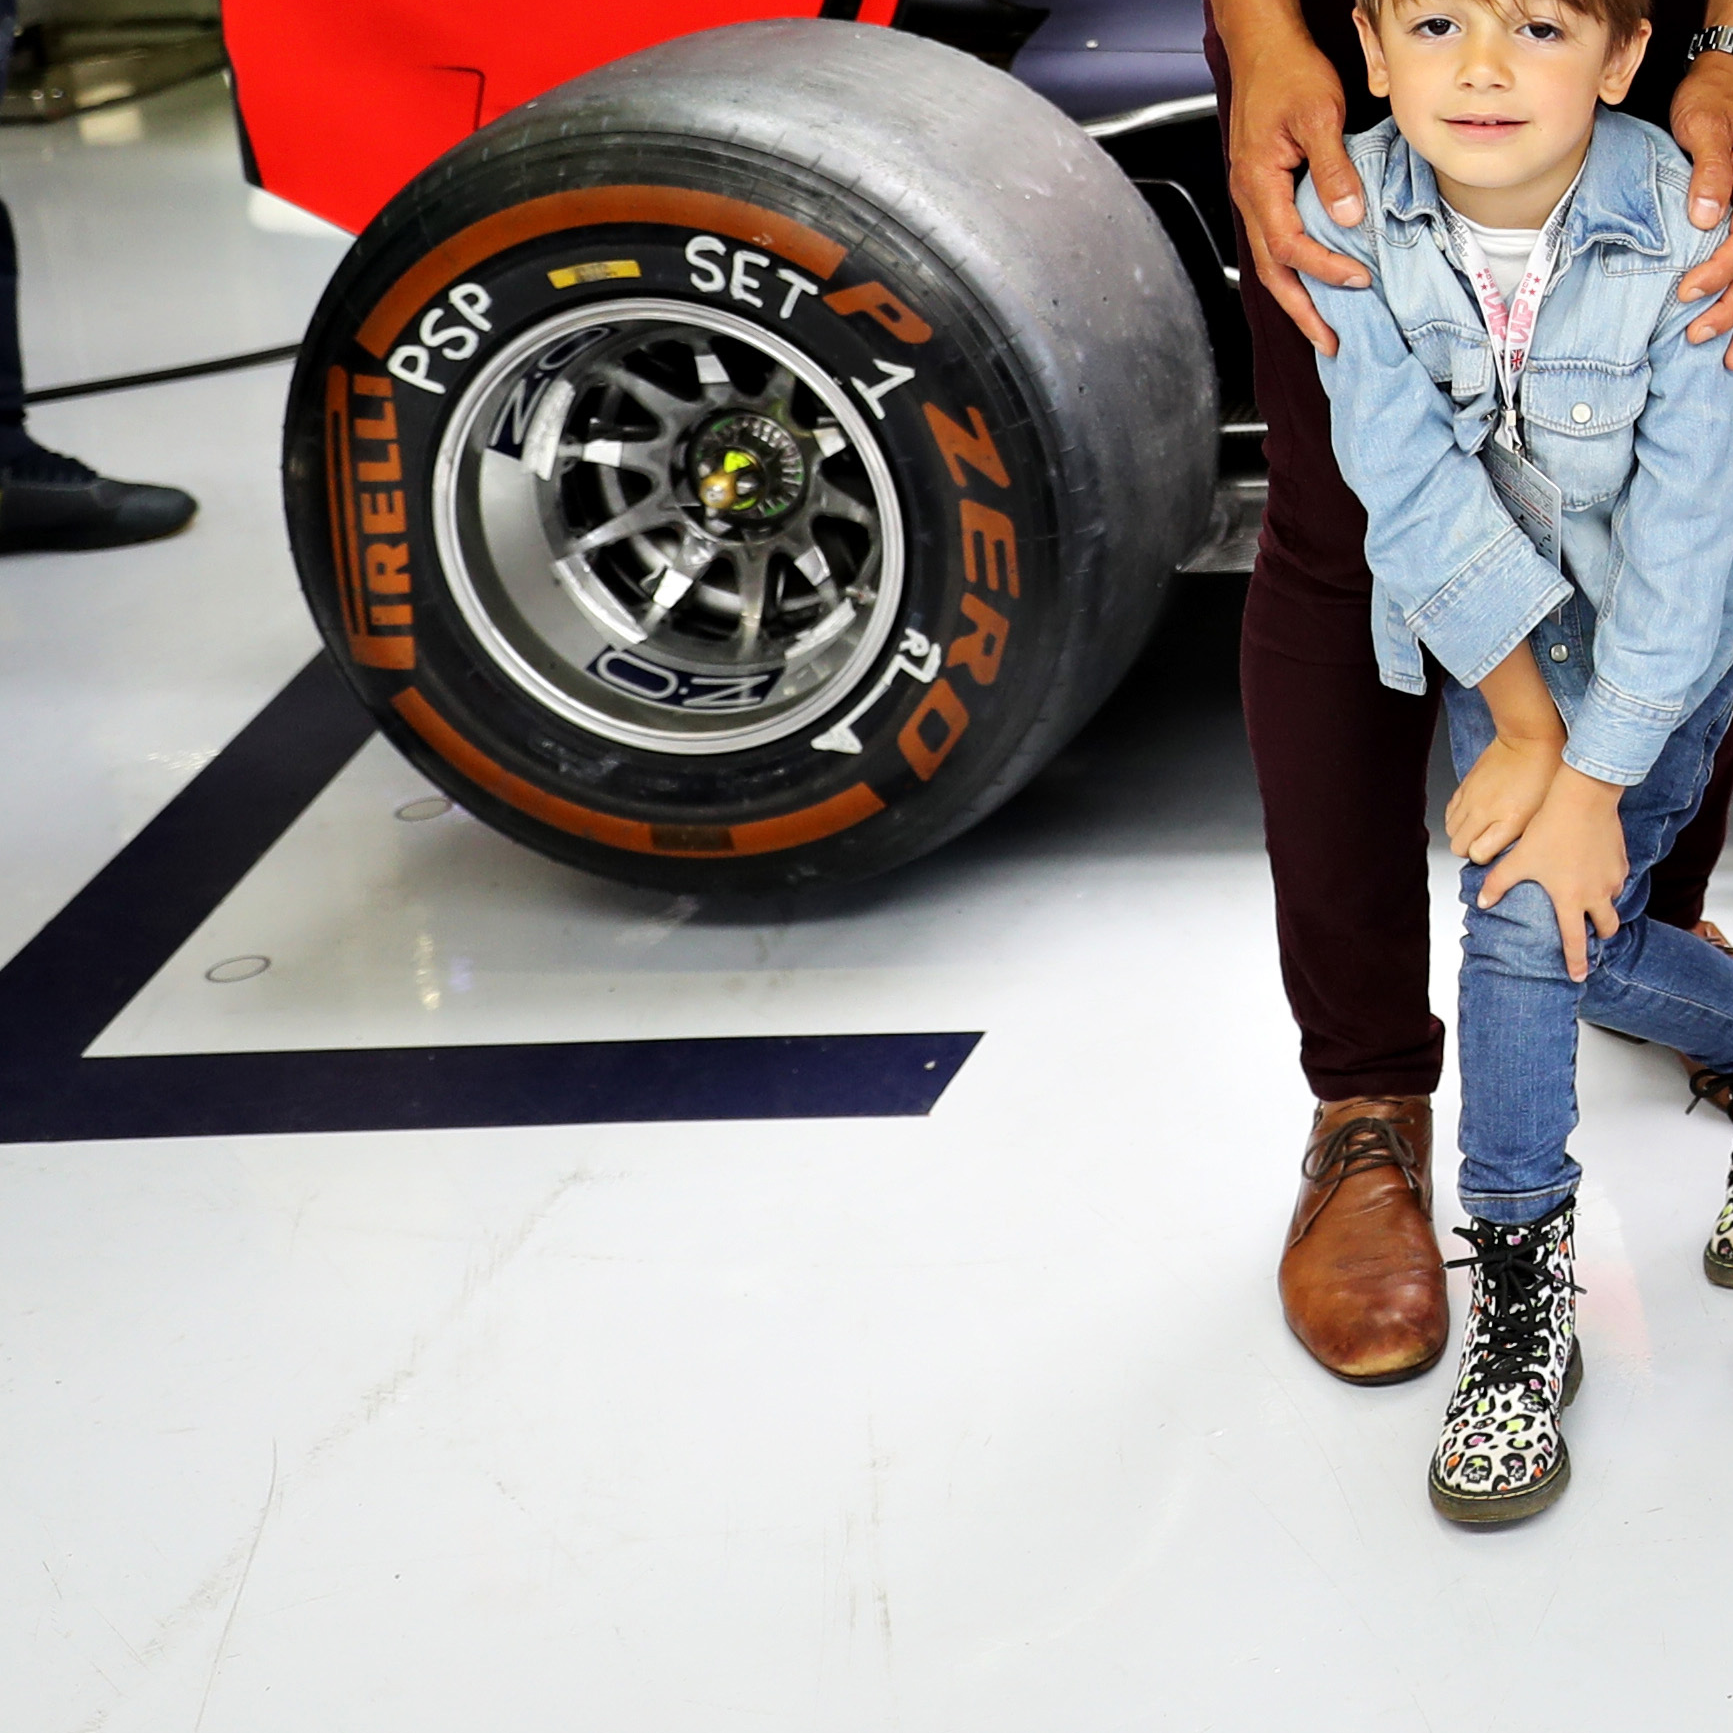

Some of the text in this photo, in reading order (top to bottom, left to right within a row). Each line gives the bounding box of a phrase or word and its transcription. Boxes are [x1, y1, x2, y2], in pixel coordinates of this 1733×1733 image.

[686, 235, 819, 320] SET
[386, 282, 494, 395] PSP
[325, 364, 418, 670] PIRELLI
